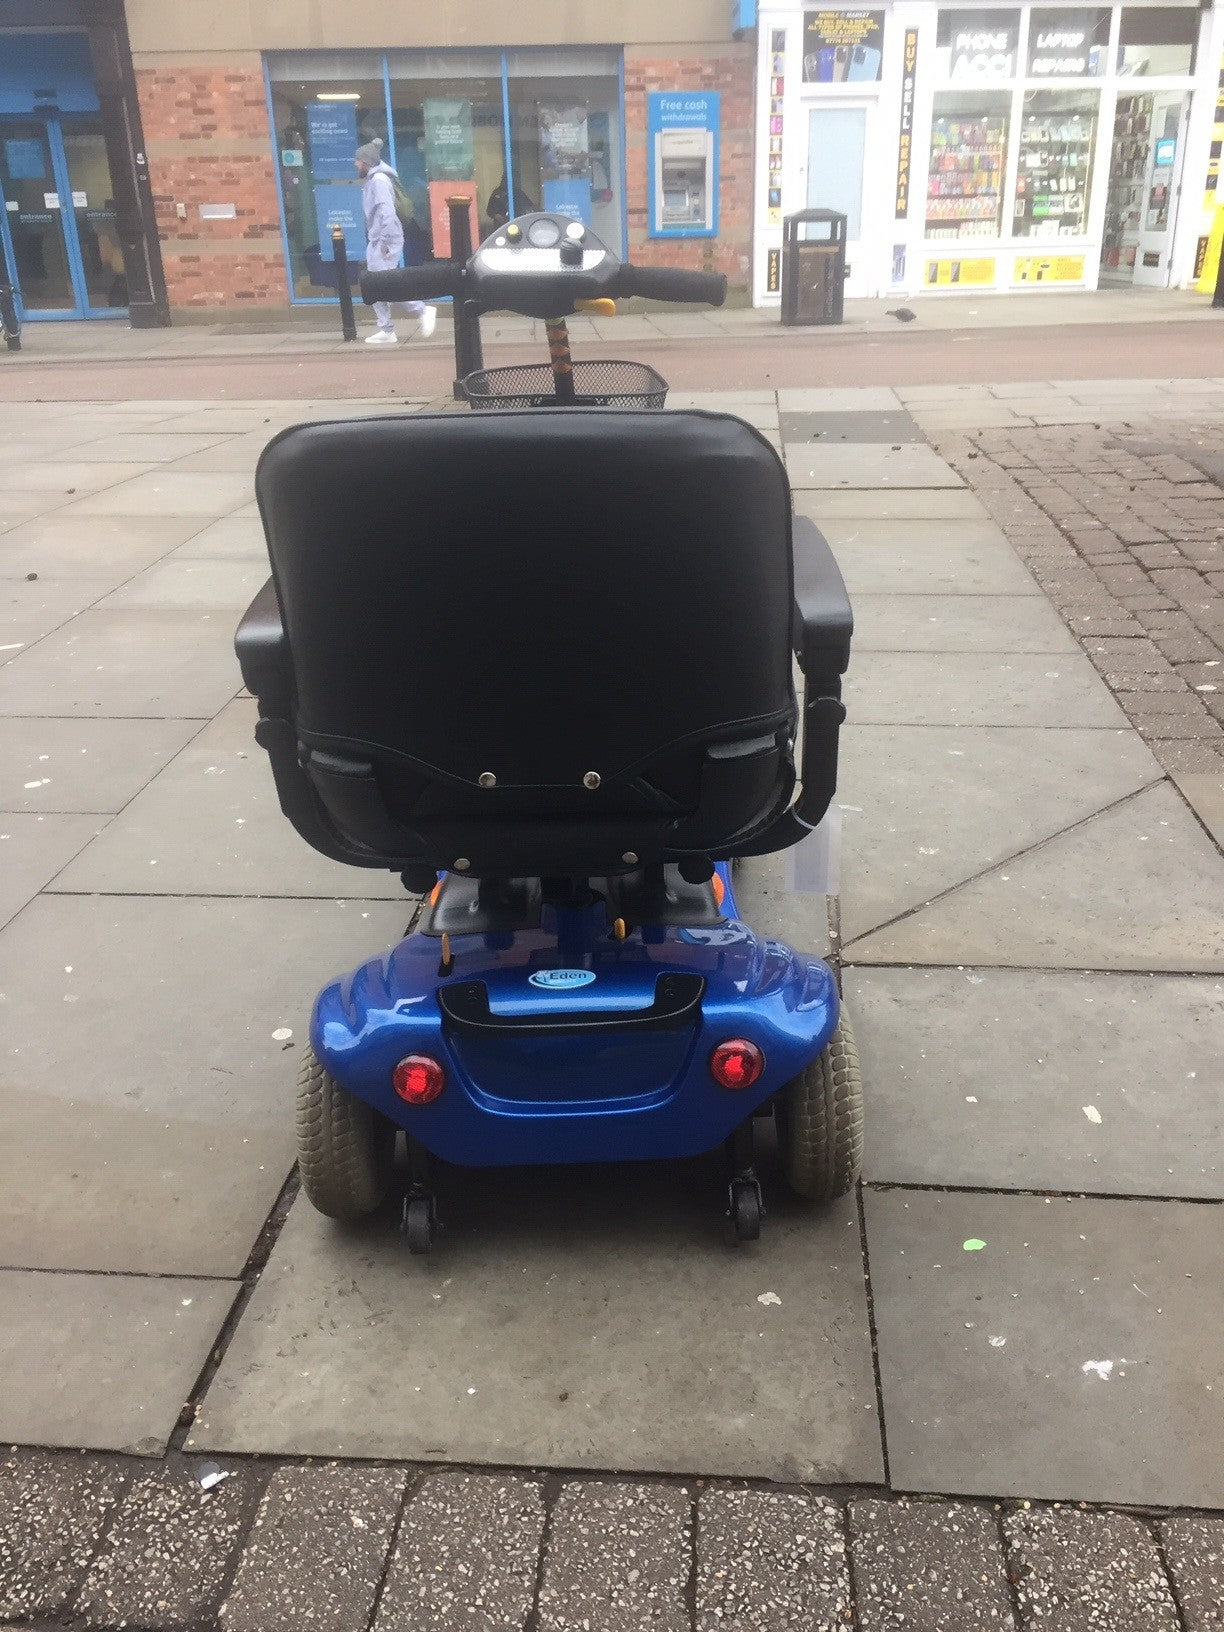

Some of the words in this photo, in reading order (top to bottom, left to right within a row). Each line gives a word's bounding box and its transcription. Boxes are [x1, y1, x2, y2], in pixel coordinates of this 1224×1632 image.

[956, 32, 1008, 50] PHONE
[1036, 32, 1086, 48] LAPTOP
[905, 33, 916, 72] BUY
[660, 99, 682, 110] Free
[684, 99, 708, 110] cash
[902, 77, 913, 130] SELL
[661, 112, 707, 122] withdrawals
[896, 134, 911, 211] REPAIR
[549, 972, 587, 980] Eden
